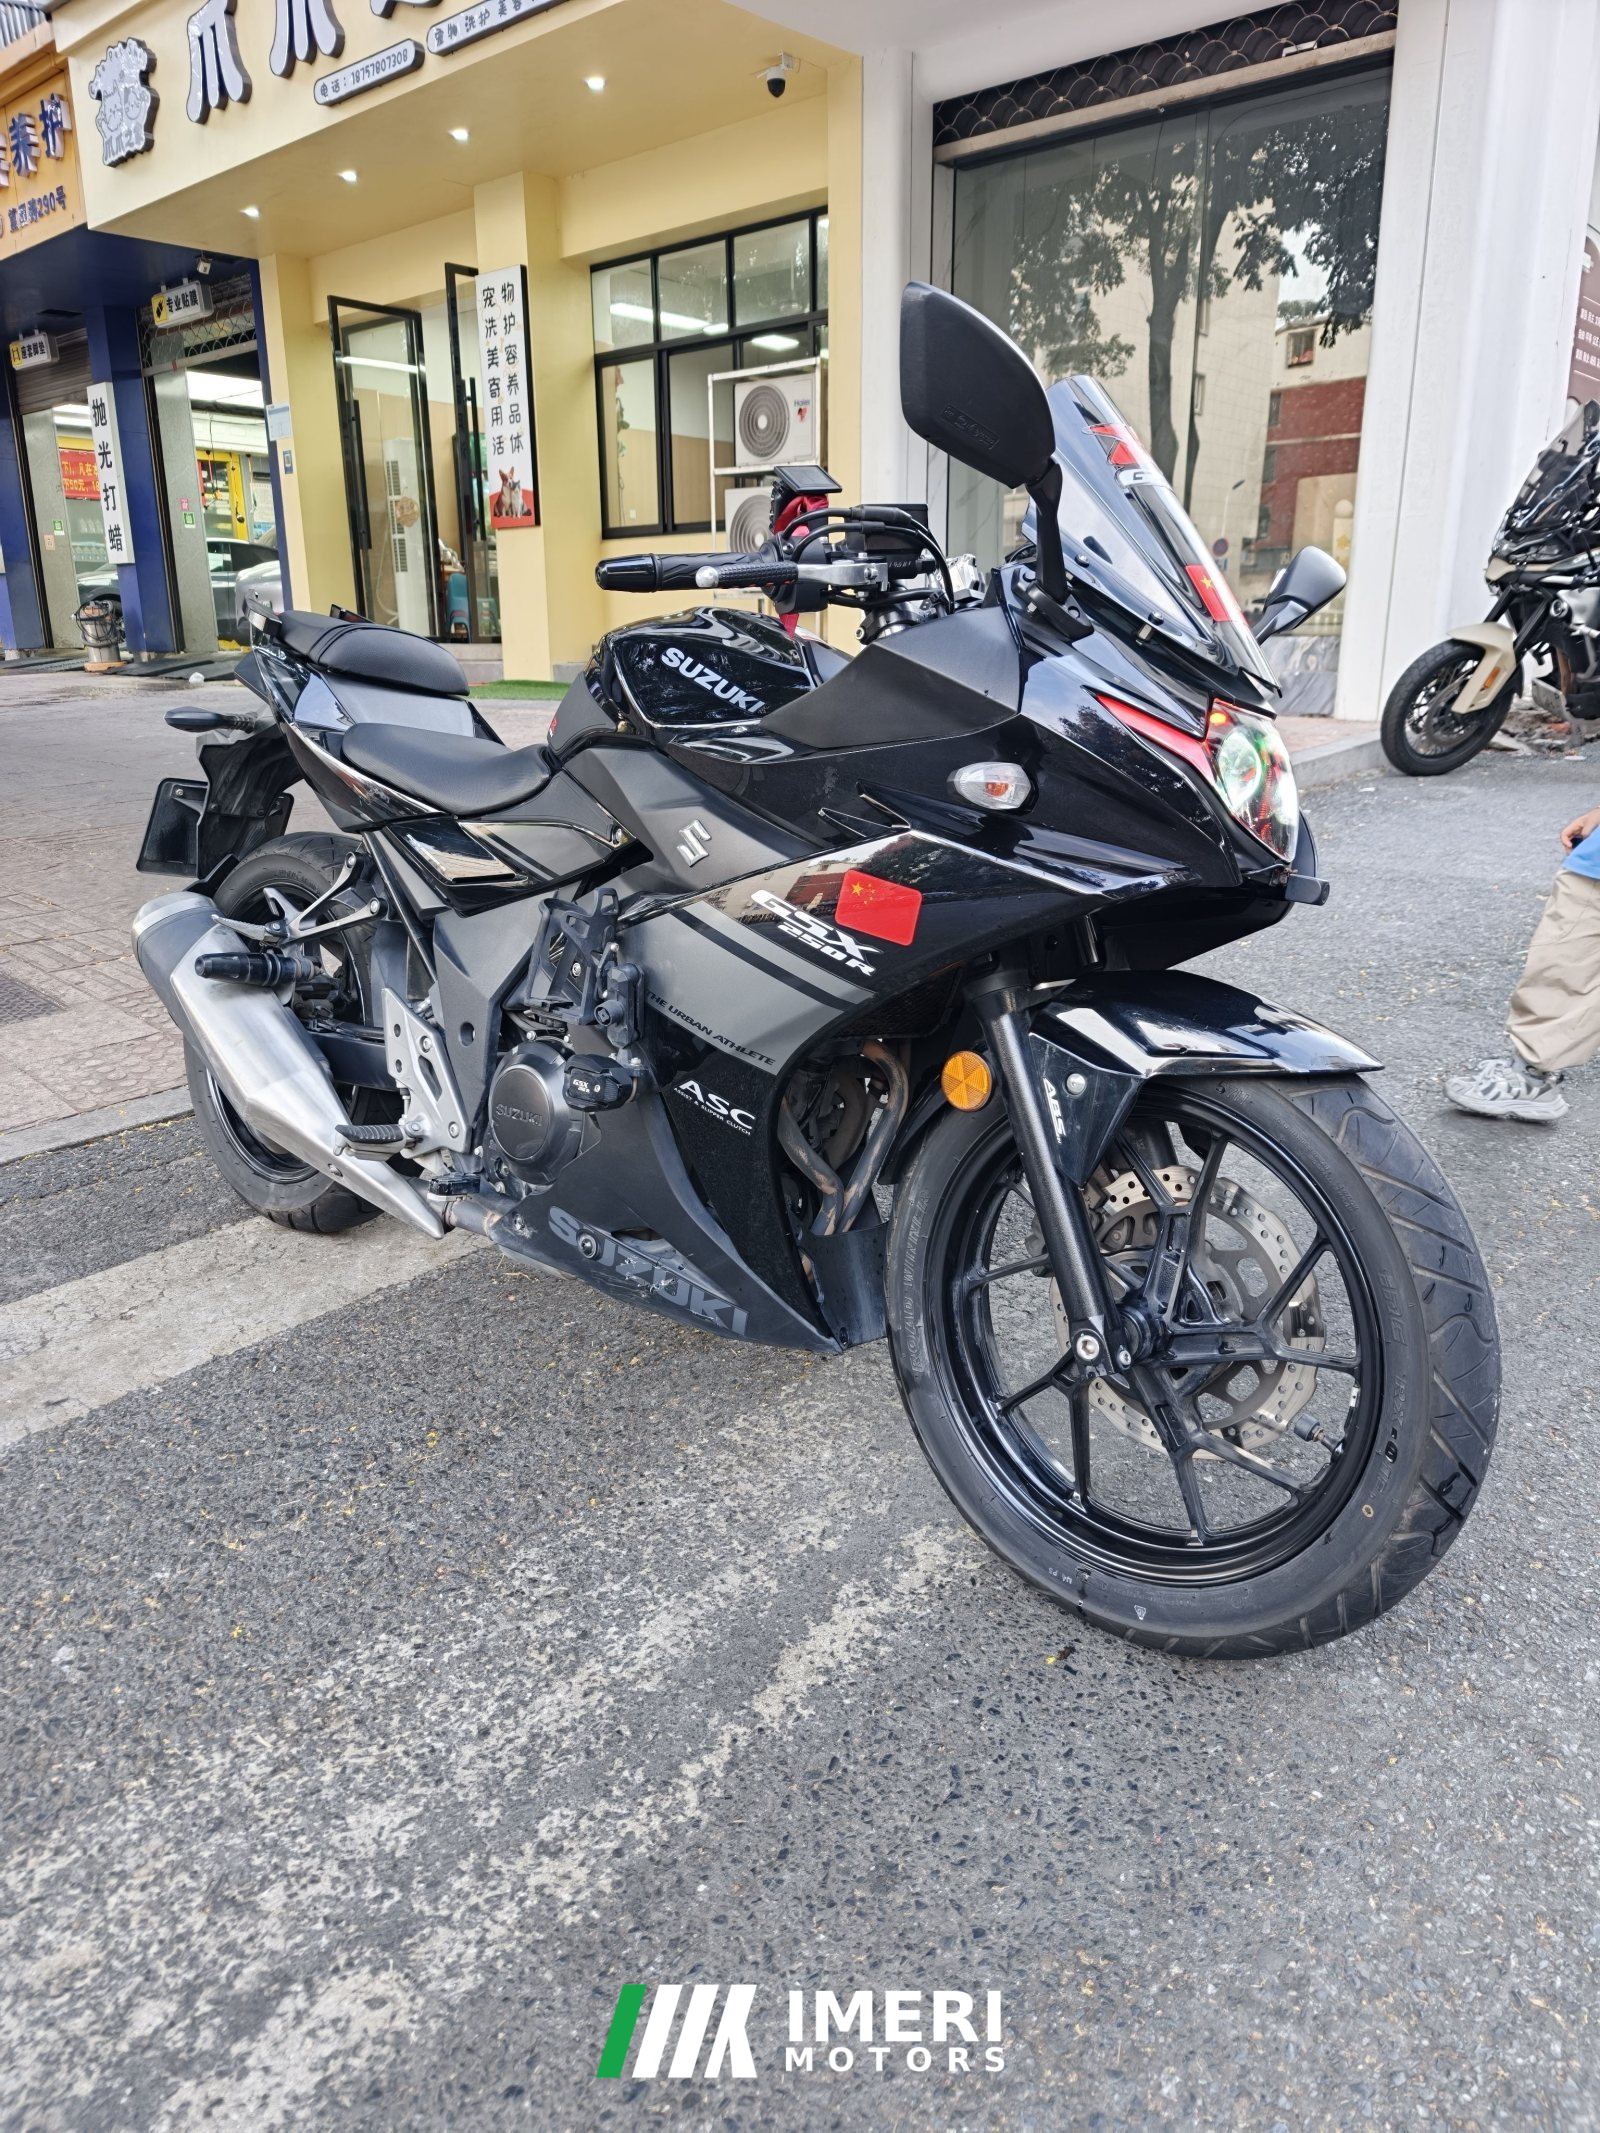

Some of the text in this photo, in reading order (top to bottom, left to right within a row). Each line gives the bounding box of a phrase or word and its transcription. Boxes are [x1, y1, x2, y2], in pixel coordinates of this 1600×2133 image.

[183, 0, 443, 124] 爪爪
[0, 92, 72, 187] 养护
[166, 288, 199, 314] 专业贴膜
[92, 397, 123, 552] 抛光打蜡
[661, 647, 766, 713] SUZUKI
[751, 889, 882, 964] GSX
[777, 921, 877, 977] 250R
[647, 991, 776, 1066] THE URBAN ATHLETE
[495, 1104, 543, 1127] SUZUKI
[673, 1087, 693, 1101] ASSIST
[700, 1104, 724, 1121] SLIPPER
[726, 1119, 751, 1136] CLUTCH
[679, 1080, 756, 1130] ASC
